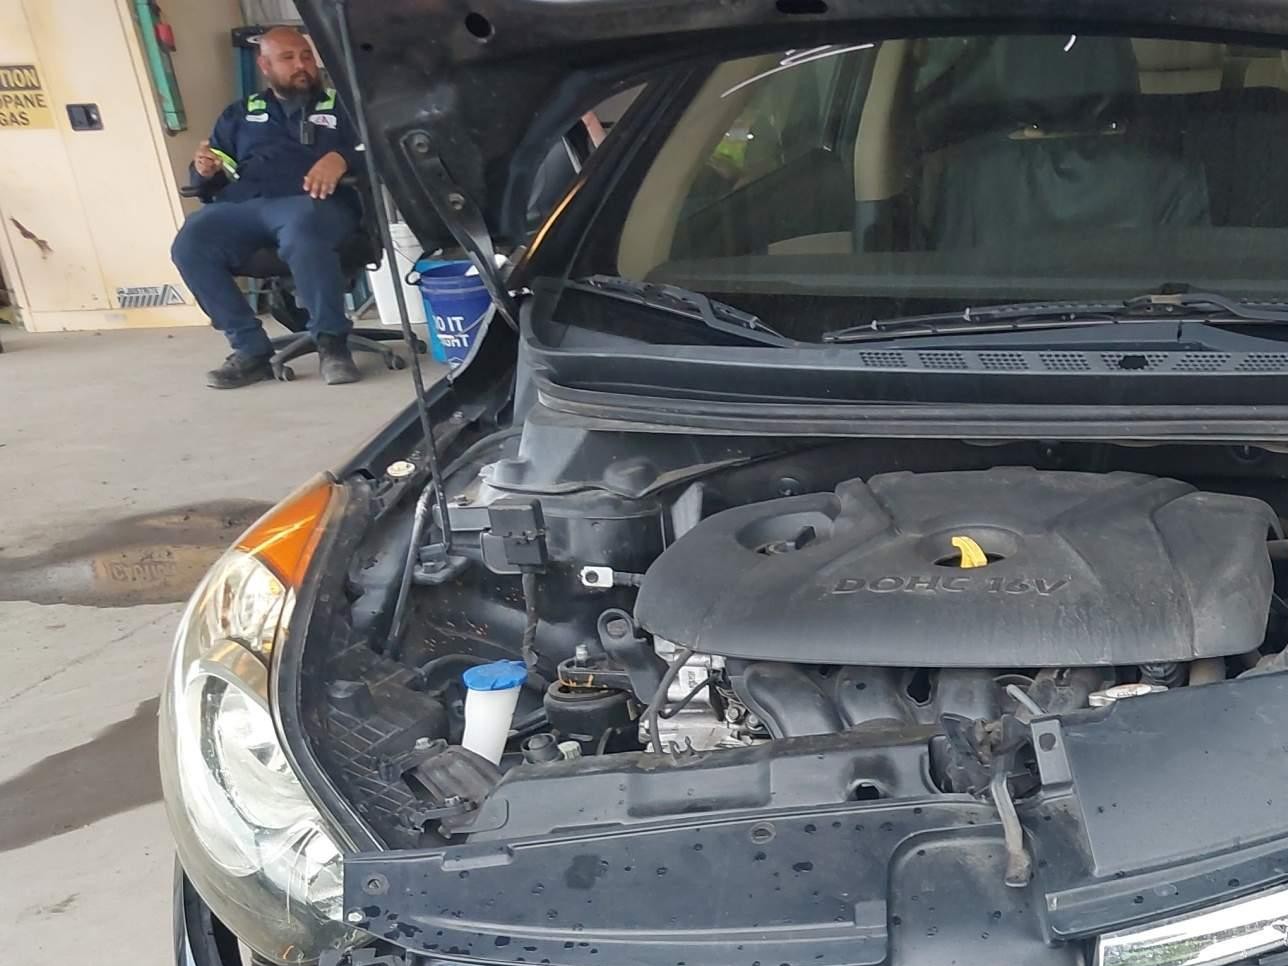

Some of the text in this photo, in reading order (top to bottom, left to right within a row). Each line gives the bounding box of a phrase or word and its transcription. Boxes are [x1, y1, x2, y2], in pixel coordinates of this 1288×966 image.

[447, 316, 464, 332] IT
[832, 575, 1071, 597] DOHC 16V
